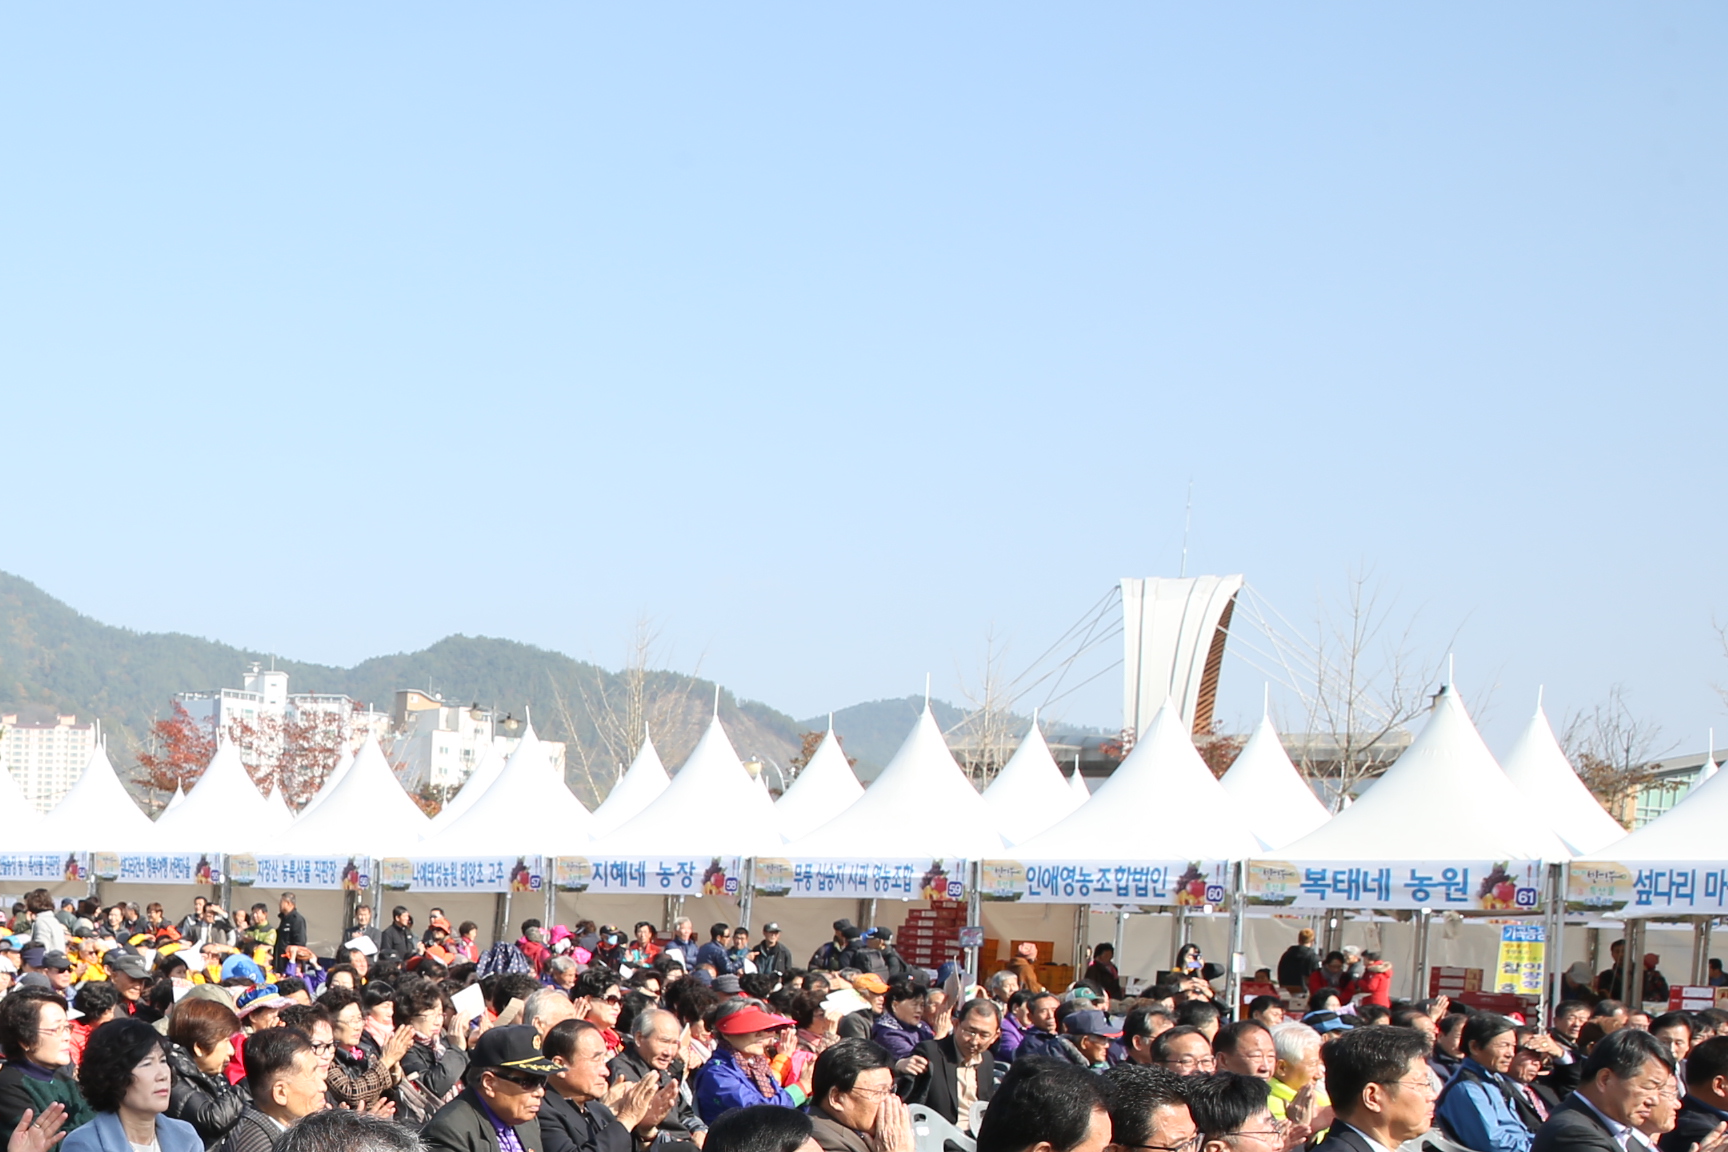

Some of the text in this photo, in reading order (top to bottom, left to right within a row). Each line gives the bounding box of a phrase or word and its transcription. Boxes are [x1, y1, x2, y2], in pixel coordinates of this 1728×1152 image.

[281, 860, 311, 884] 농특산물
[315, 860, 337, 884] 직판장
[460, 861, 485, 887] 태양초
[488, 860, 504, 887] 고추
[592, 860, 646, 887] 지혜네
[655, 860, 696, 888] 농장
[726, 879, 737, 890] 58
[793, 863, 813, 891] 무풍
[816, 863, 845, 891] 십승지
[847, 863, 869, 892] 사과
[872, 863, 915, 893] 영농조합
[1025, 865, 1168, 898] 인애영농조합법인
[1300, 868, 1469, 902] 복태네 농원
[948, 883, 962, 896] 59
[1207, 887, 1223, 900] 60
[1517, 890, 1535, 905] 61
[1633, 869, 1696, 906] 섶다리
